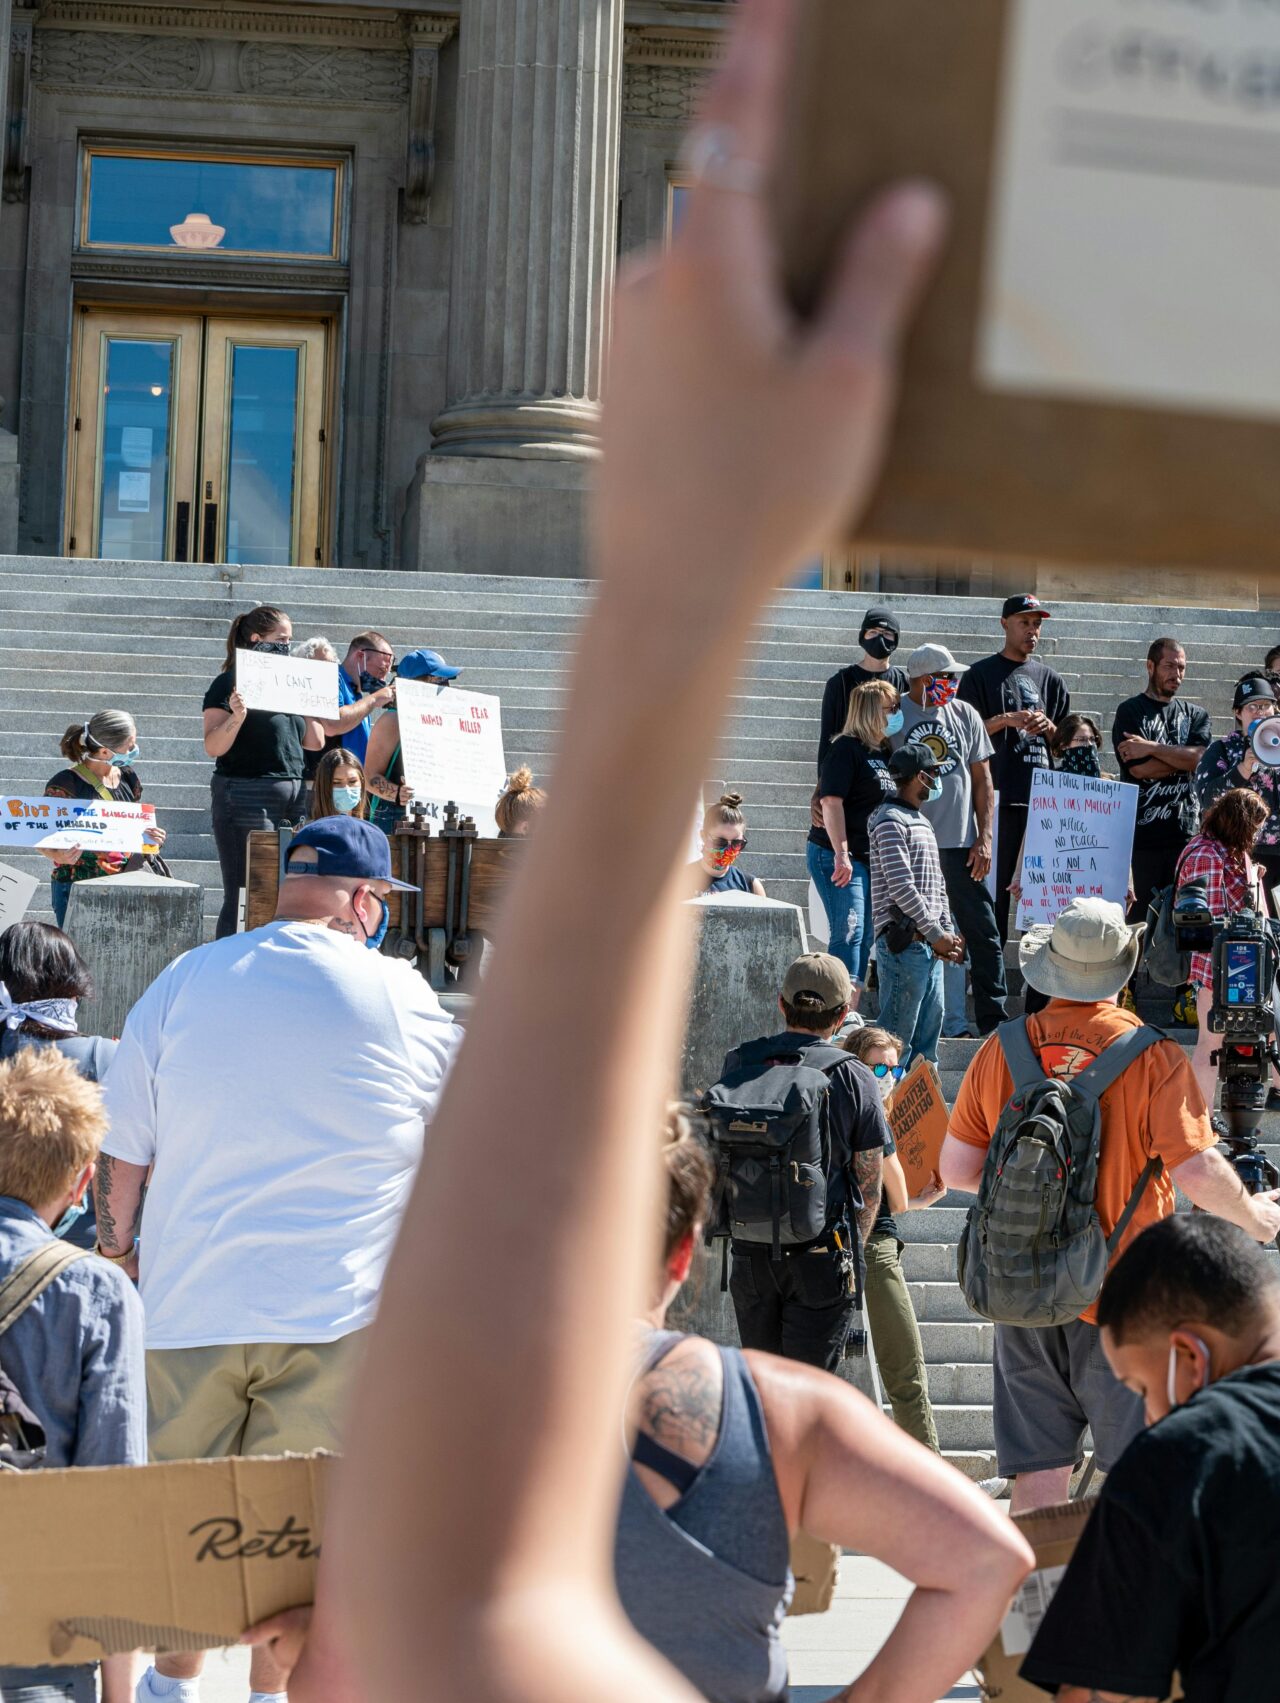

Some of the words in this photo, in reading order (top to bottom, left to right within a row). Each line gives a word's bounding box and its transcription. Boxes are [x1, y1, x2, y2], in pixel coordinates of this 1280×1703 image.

[73, 806, 98, 817] THE
[5, 822, 21, 830] OF
[26, 822, 49, 830] THE
[188, 1516, 321, 1562] Retr
